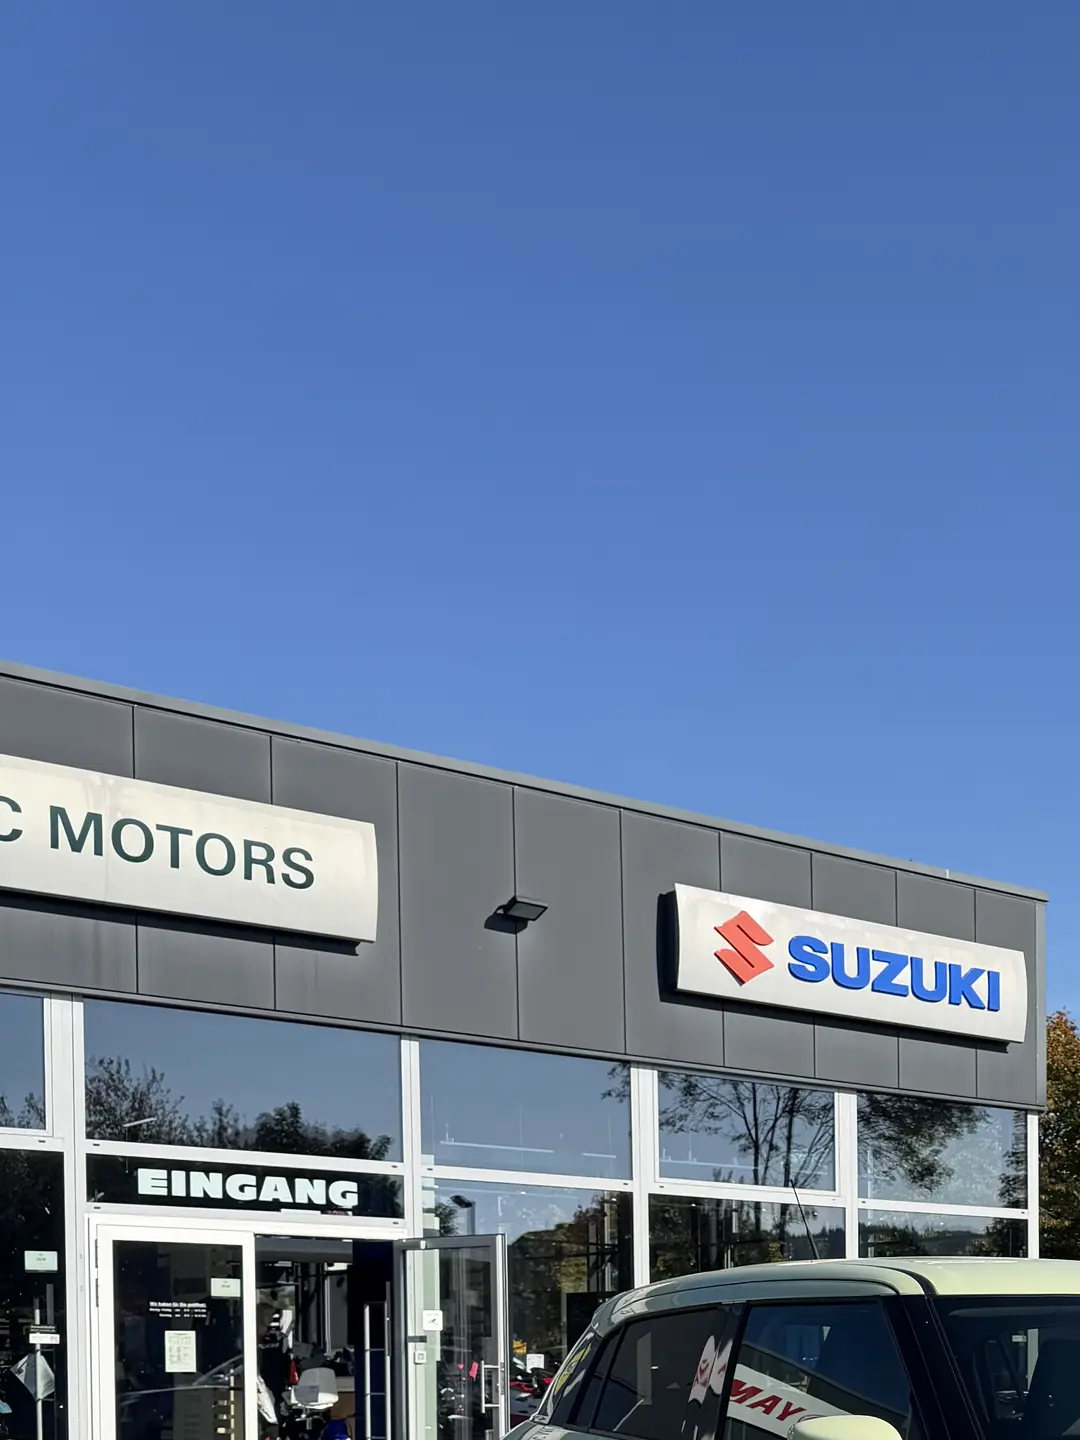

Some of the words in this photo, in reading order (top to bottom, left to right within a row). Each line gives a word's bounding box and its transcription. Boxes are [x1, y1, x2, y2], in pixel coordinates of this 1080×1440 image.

[49, 804, 315, 890] MOTORS
[788, 935, 1000, 1012] SUZUKI
[137, 1168, 358, 1208] EINGANG
